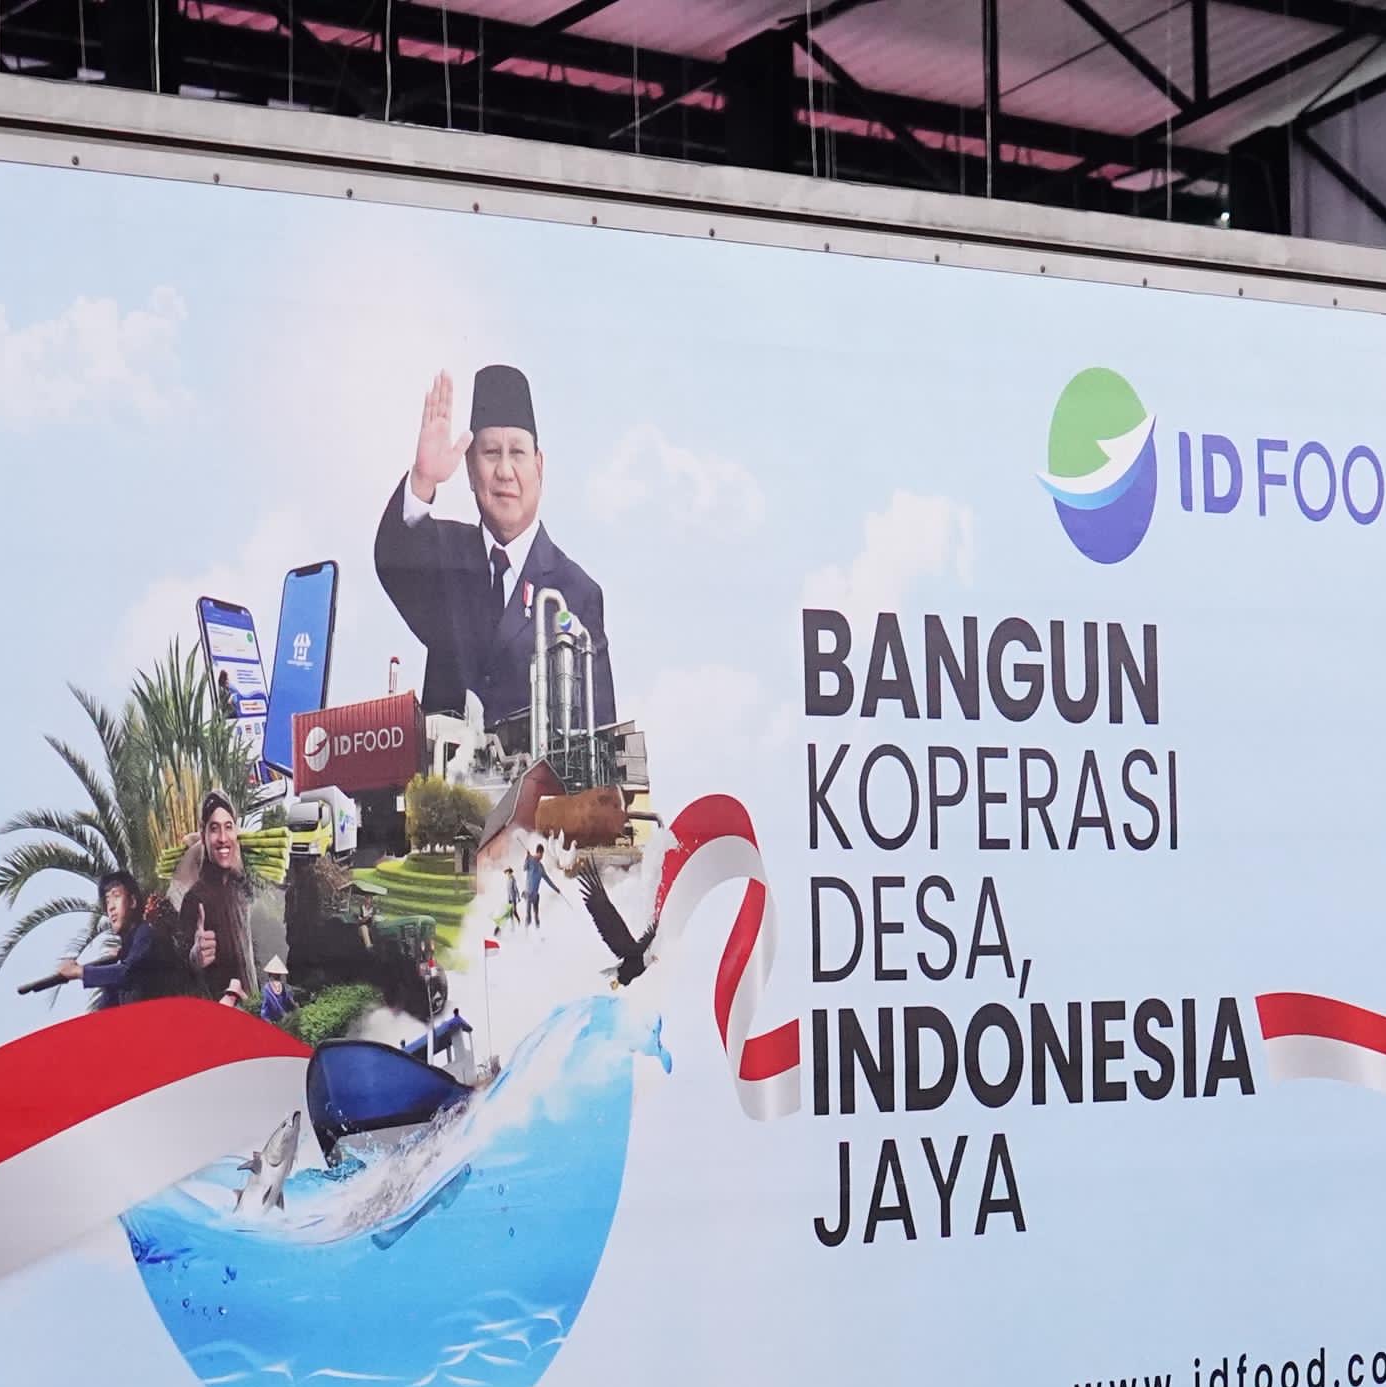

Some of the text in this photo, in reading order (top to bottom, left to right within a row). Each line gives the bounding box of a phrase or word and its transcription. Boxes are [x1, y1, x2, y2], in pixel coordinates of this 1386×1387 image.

[802, 607, 1160, 726] BANGUN
[806, 743, 1179, 852] KOPERASI
[810, 874, 1033, 999] DESA,
[811, 996, 1257, 1116] INDONESIA
[814, 1133, 1027, 1248] JAYA
